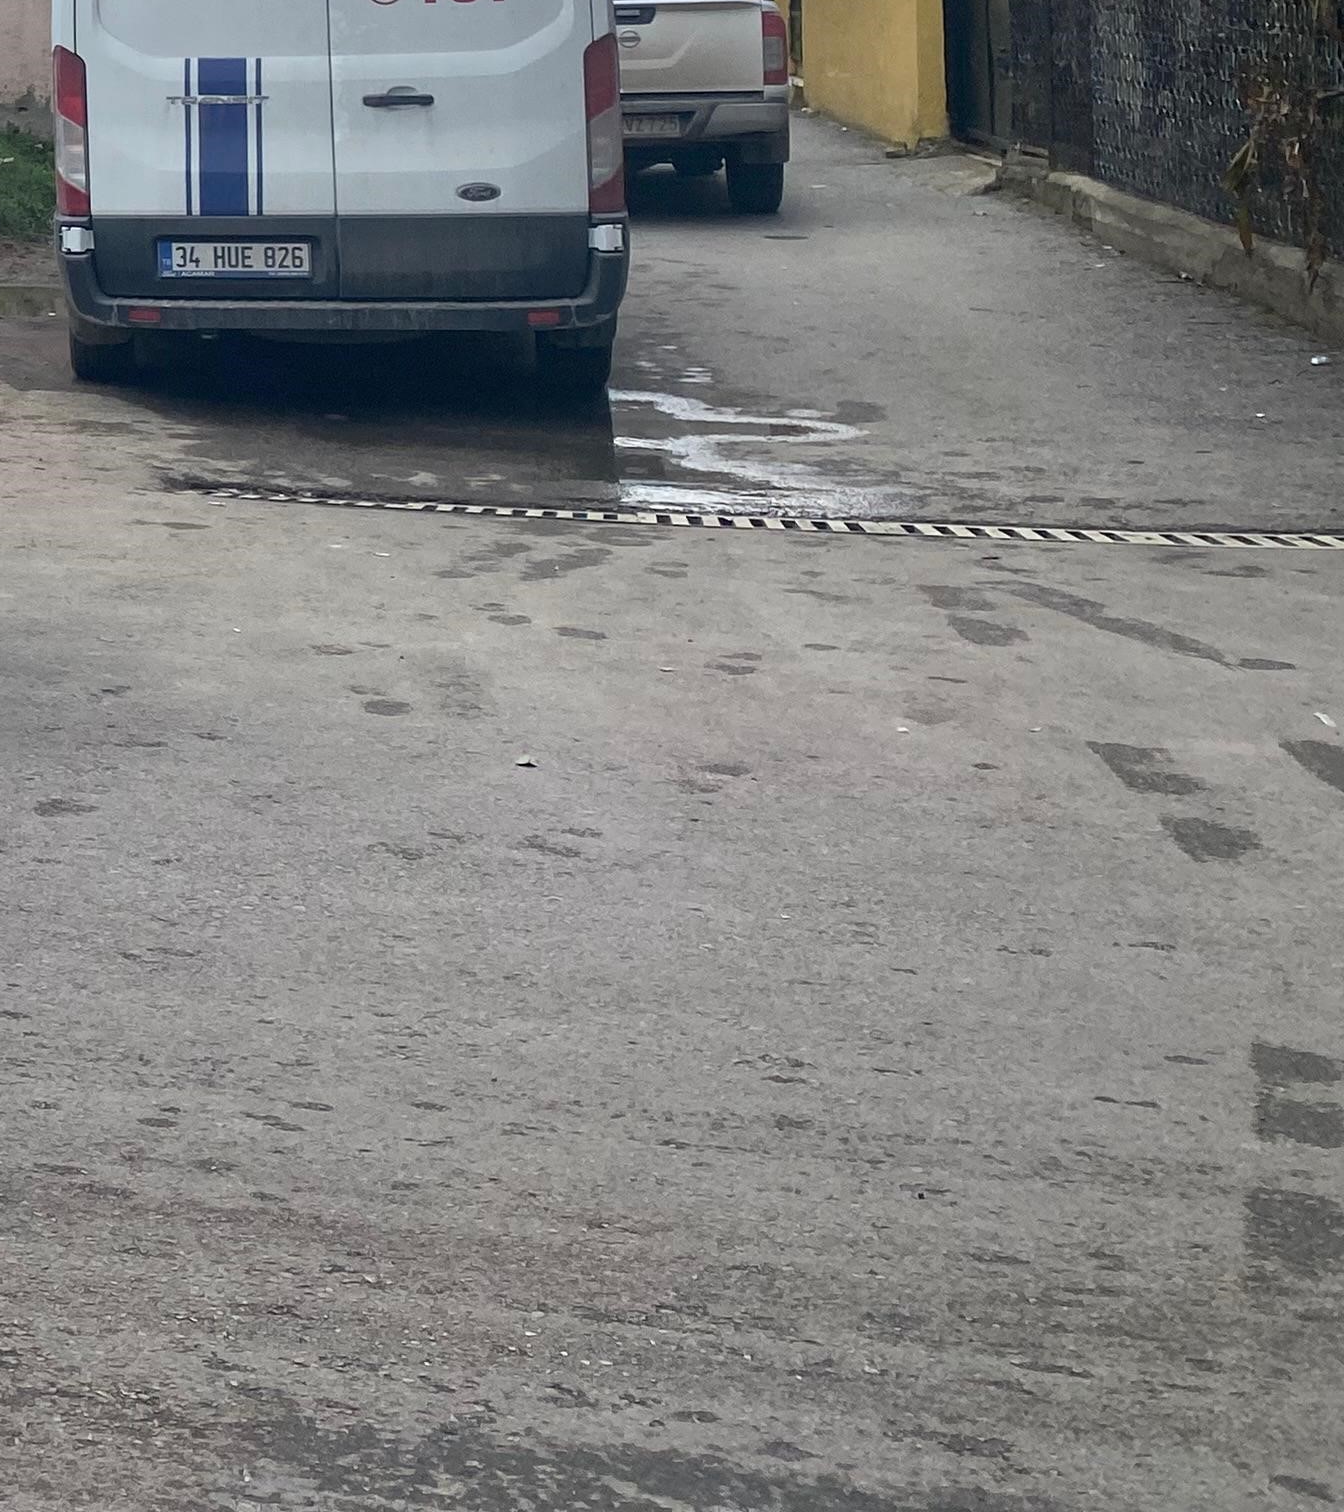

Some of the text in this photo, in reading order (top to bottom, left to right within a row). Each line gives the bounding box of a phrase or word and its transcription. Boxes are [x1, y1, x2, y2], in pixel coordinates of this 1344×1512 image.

[175, 246, 200, 268] 34
[213, 246, 253, 268] HUE
[264, 246, 304, 268] 826
